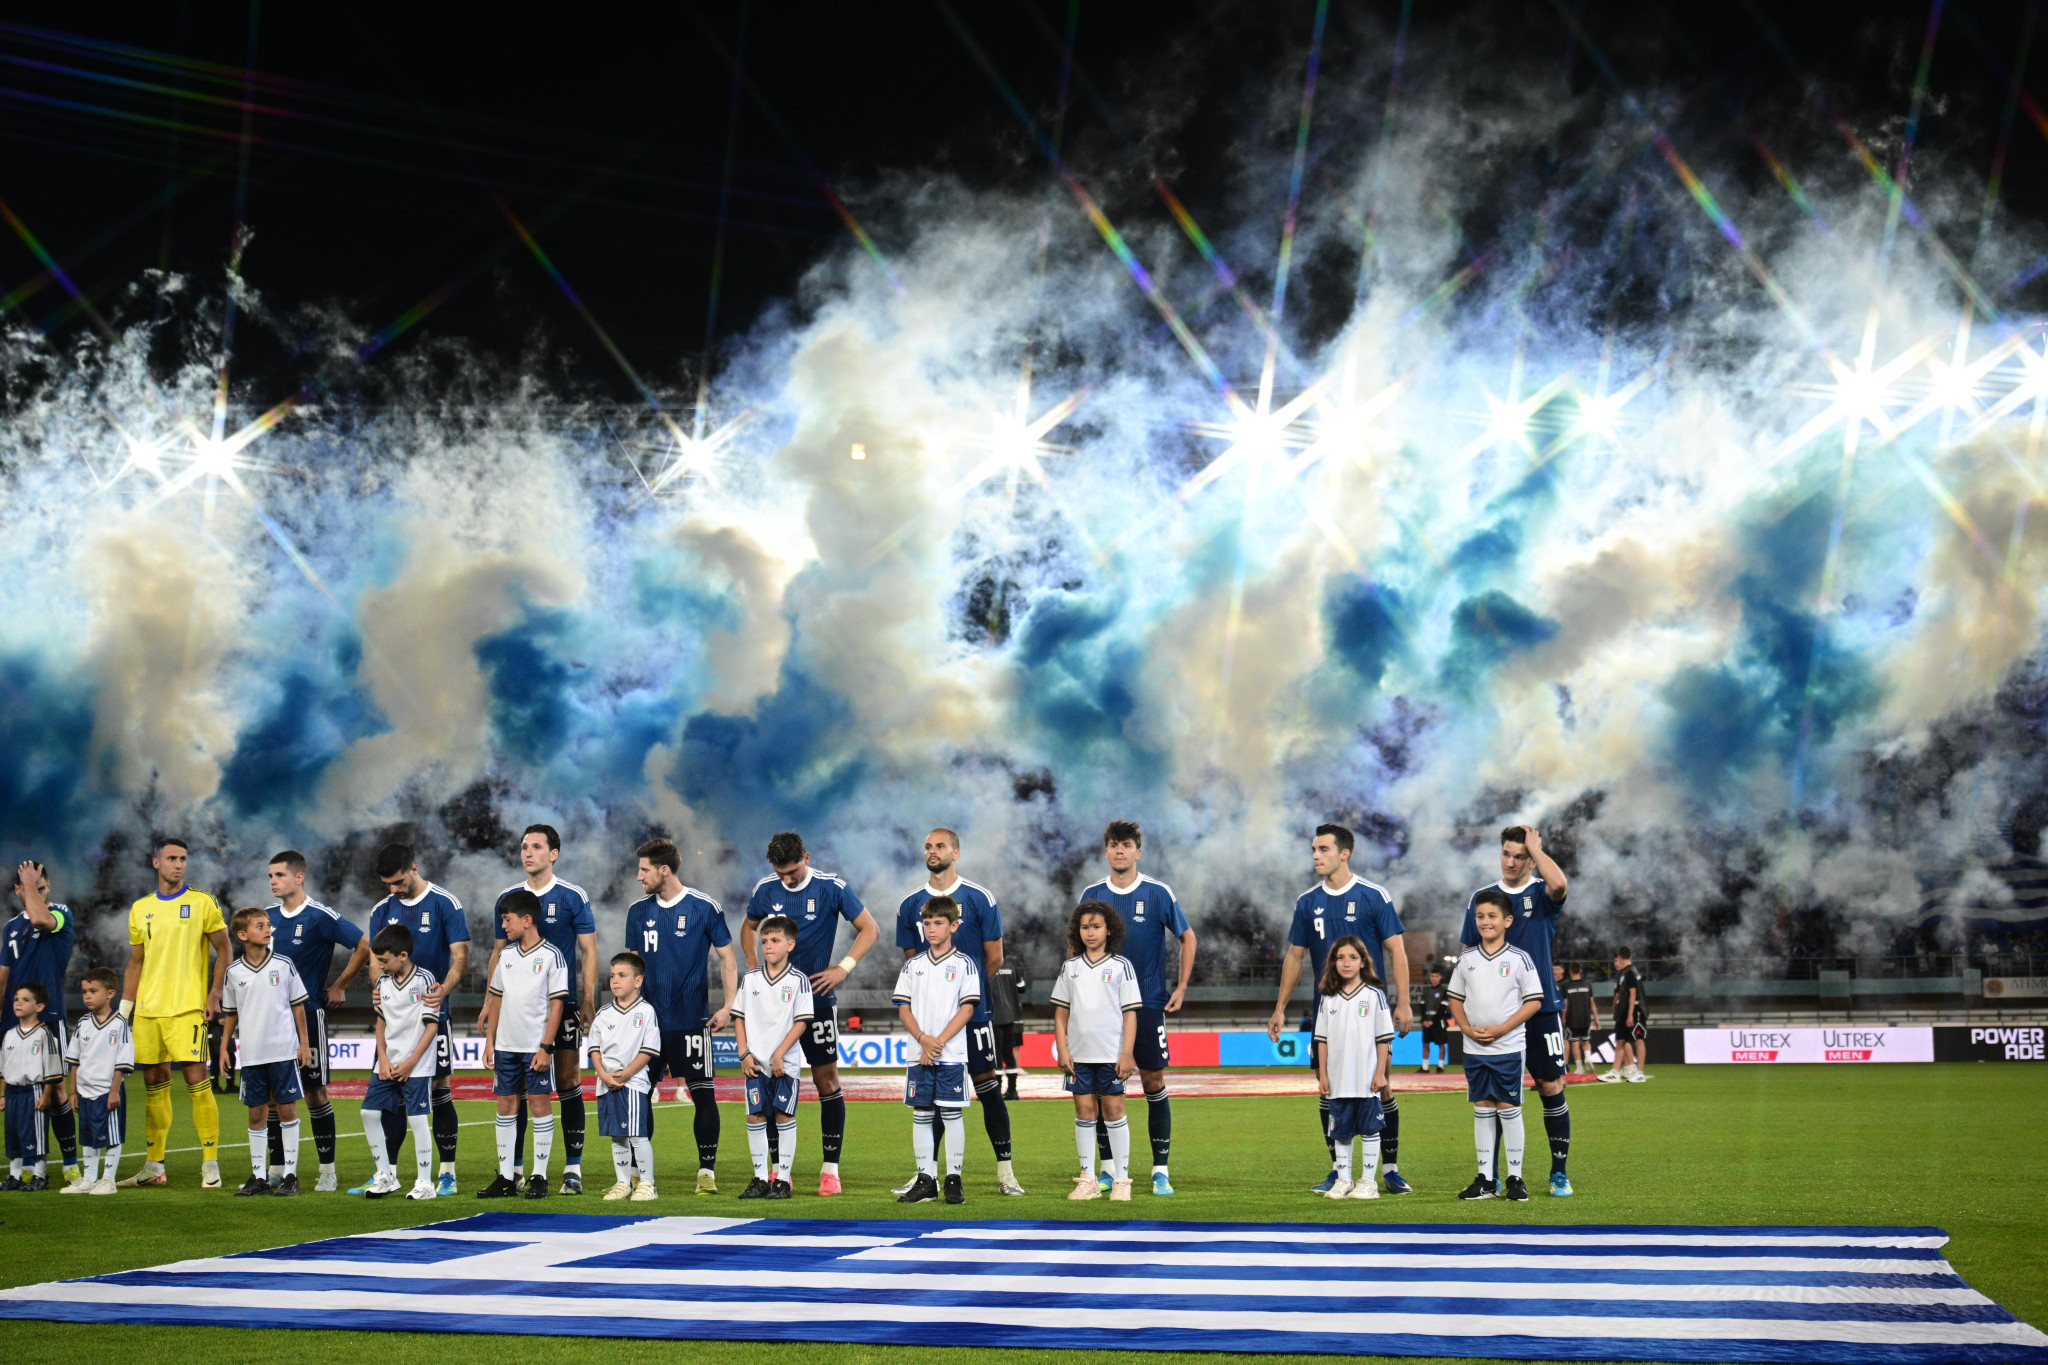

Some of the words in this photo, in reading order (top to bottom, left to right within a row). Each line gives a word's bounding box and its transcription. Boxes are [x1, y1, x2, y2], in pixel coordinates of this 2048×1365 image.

[147, 922, 152, 940] 1
[1313, 917, 1325, 940] 9
[643, 930, 658, 953] 19
[193, 1024, 199, 1044] 1
[812, 1019, 836, 1044] 23
[973, 1026, 992, 1051] 17
[1157, 1025, 1167, 1049] 2
[1730, 1031, 1791, 1048] ULTREX
[1823, 1030, 1885, 1047] ULTREX
[1971, 1028, 2044, 1044] POWER
[436, 1034, 449, 1057] 3
[684, 1035, 703, 1057] 19
[838, 1038, 907, 1065] volt
[1543, 1032, 1563, 1056] 10
[2005, 1044, 2045, 1060] ADE
[1735, 1052, 1769, 1060] MEN
[1828, 1052, 1863, 1060] MEN
